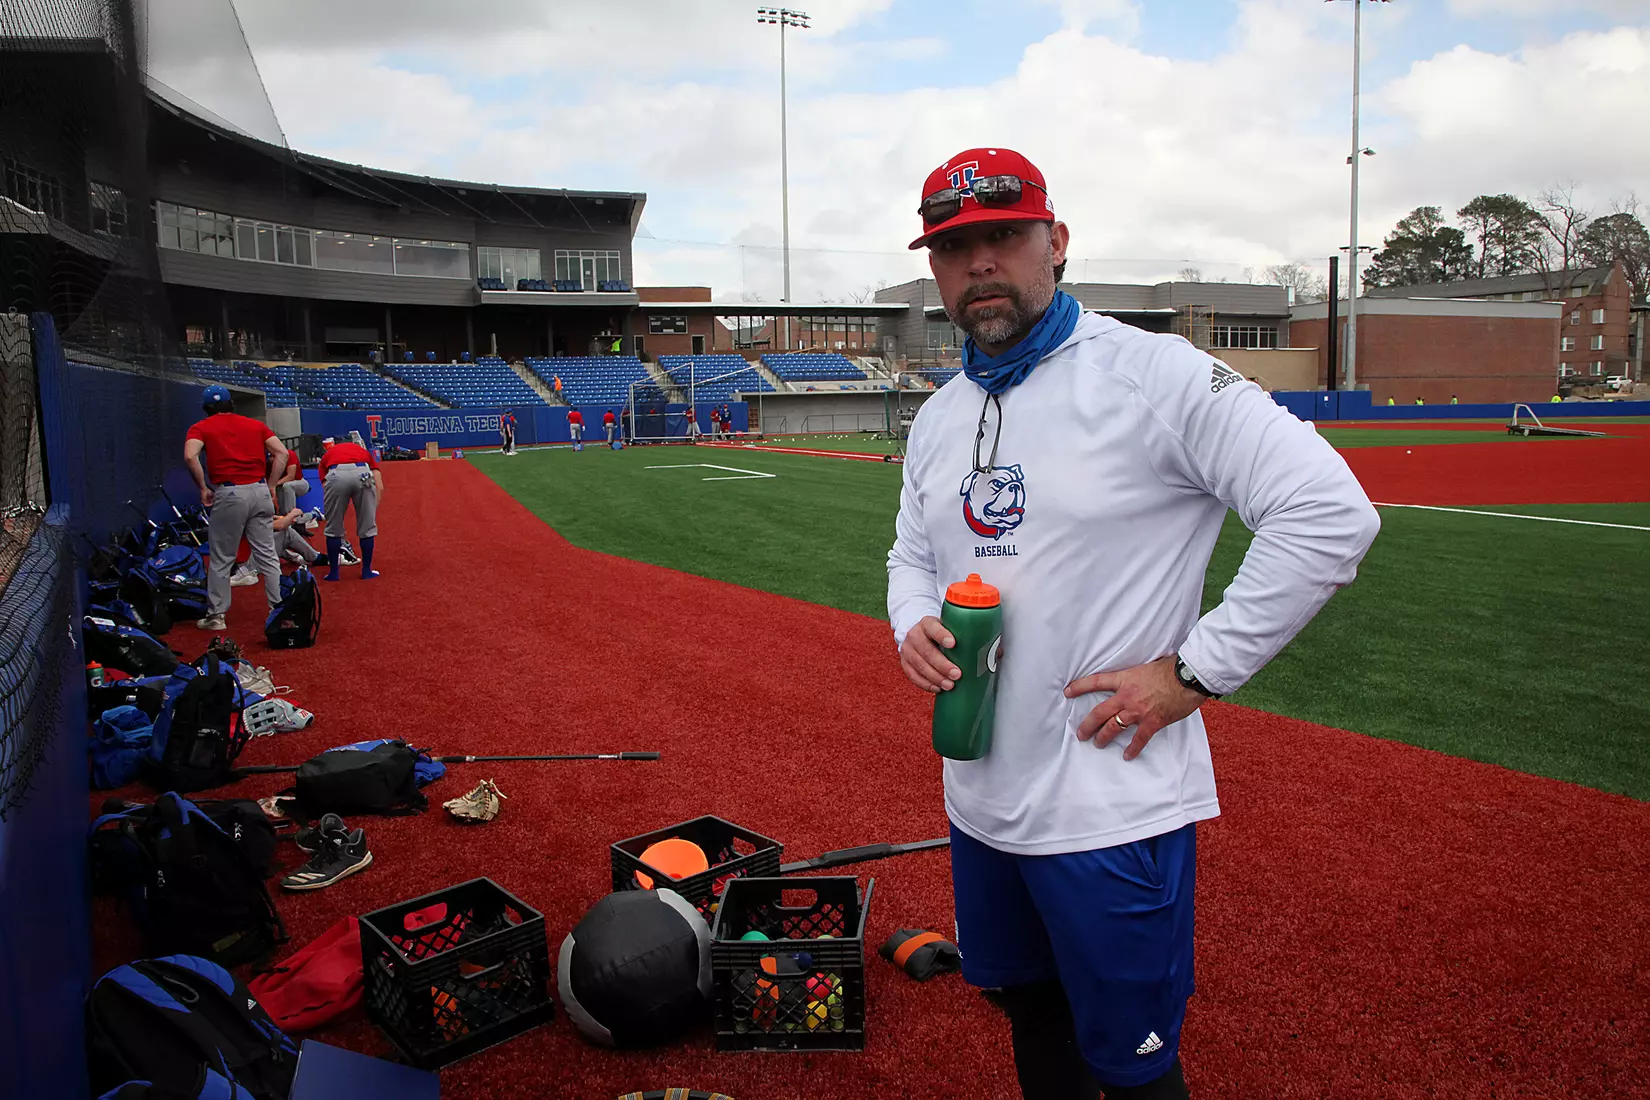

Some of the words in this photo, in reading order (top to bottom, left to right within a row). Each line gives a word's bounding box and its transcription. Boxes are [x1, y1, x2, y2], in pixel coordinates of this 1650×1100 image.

[1210, 374, 1243, 394] adidas
[386, 416, 464, 436] LOUISIANA
[974, 544, 1018, 558] BASEBALL
[1136, 1041, 1164, 1055] adidas
